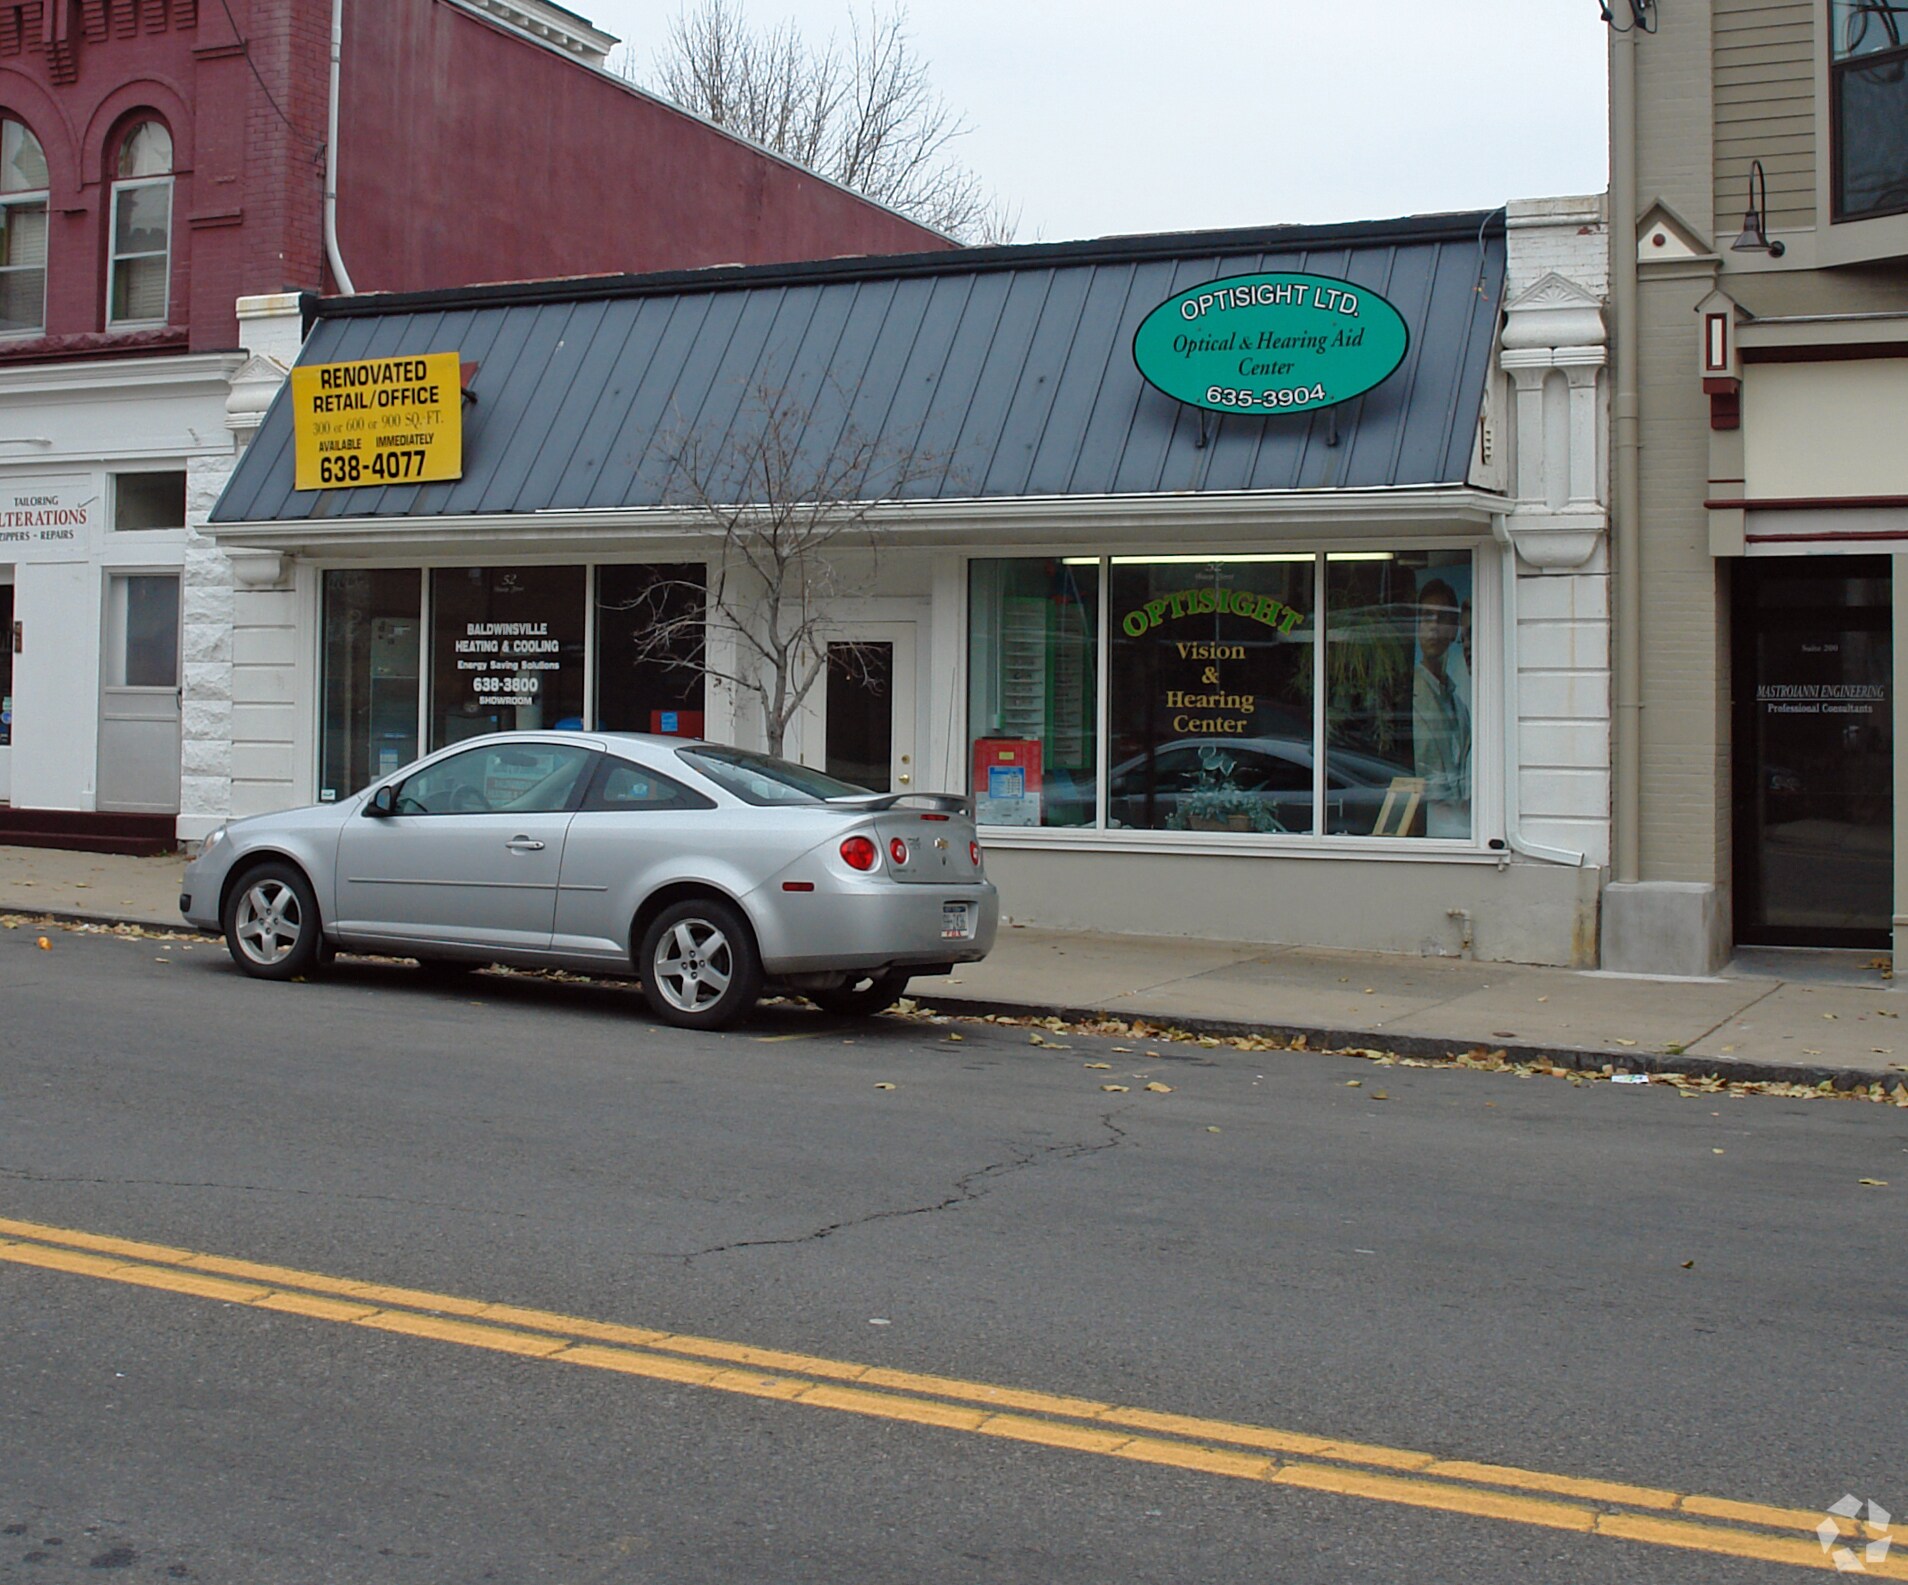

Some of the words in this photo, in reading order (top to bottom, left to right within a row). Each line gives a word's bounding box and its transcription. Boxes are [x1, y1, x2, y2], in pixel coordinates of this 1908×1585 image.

[1180, 283, 1309, 321] OPTISIGHT
[1313, 286, 1359, 317] LTD.
[1173, 332, 1236, 358] Optical
[1239, 336, 1253, 350] &
[1256, 330, 1328, 354] Hearing
[1330, 327, 1365, 347] Aid
[320, 360, 427, 390] RENOVATED
[1237, 357, 1295, 376] Center
[313, 386, 439, 413] RETAIL/OFFICE
[1206, 383, 1326, 409] 635-3904
[312, 421, 330, 435] 300
[333, 424, 343, 433] or
[346, 417, 365, 431] 600
[367, 420, 378, 429] or
[381, 414, 401, 428] 900
[405, 412, 423, 429] SQ.
[427, 410, 444, 424] FT.
[319, 438, 362, 452] AVAILABLE
[376, 433, 434, 448] IMMEDIATELY
[320, 450, 426, 483] 638-4077
[14, 495, 58, 507] TAILORING
[40, 529, 74, 540] REPAIRS
[1122, 588, 1305, 637] OPTISIGHT
[467, 623, 548, 635] BALDWINSVILLE
[455, 640, 498, 652] HEATING
[501, 640, 509, 652] &
[513, 640, 559, 652] COOLING
[1175, 641, 1246, 660] Vision
[457, 660, 488, 671] Energy
[490, 660, 519, 671] Saving
[521, 660, 560, 670] Solutions
[1201, 666, 1219, 684] &
[472, 677, 539, 692] 638-3800
[1757, 685, 1820, 697] MASTROIANNI
[1821, 685, 1884, 697] ENGINEERING
[479, 696, 533, 705] SHOWROOM
[1166, 691, 1255, 713] Hearing
[1768, 703, 1820, 713] Professional
[1822, 703, 1873, 713] Consultants
[1173, 715, 1248, 733] Center
